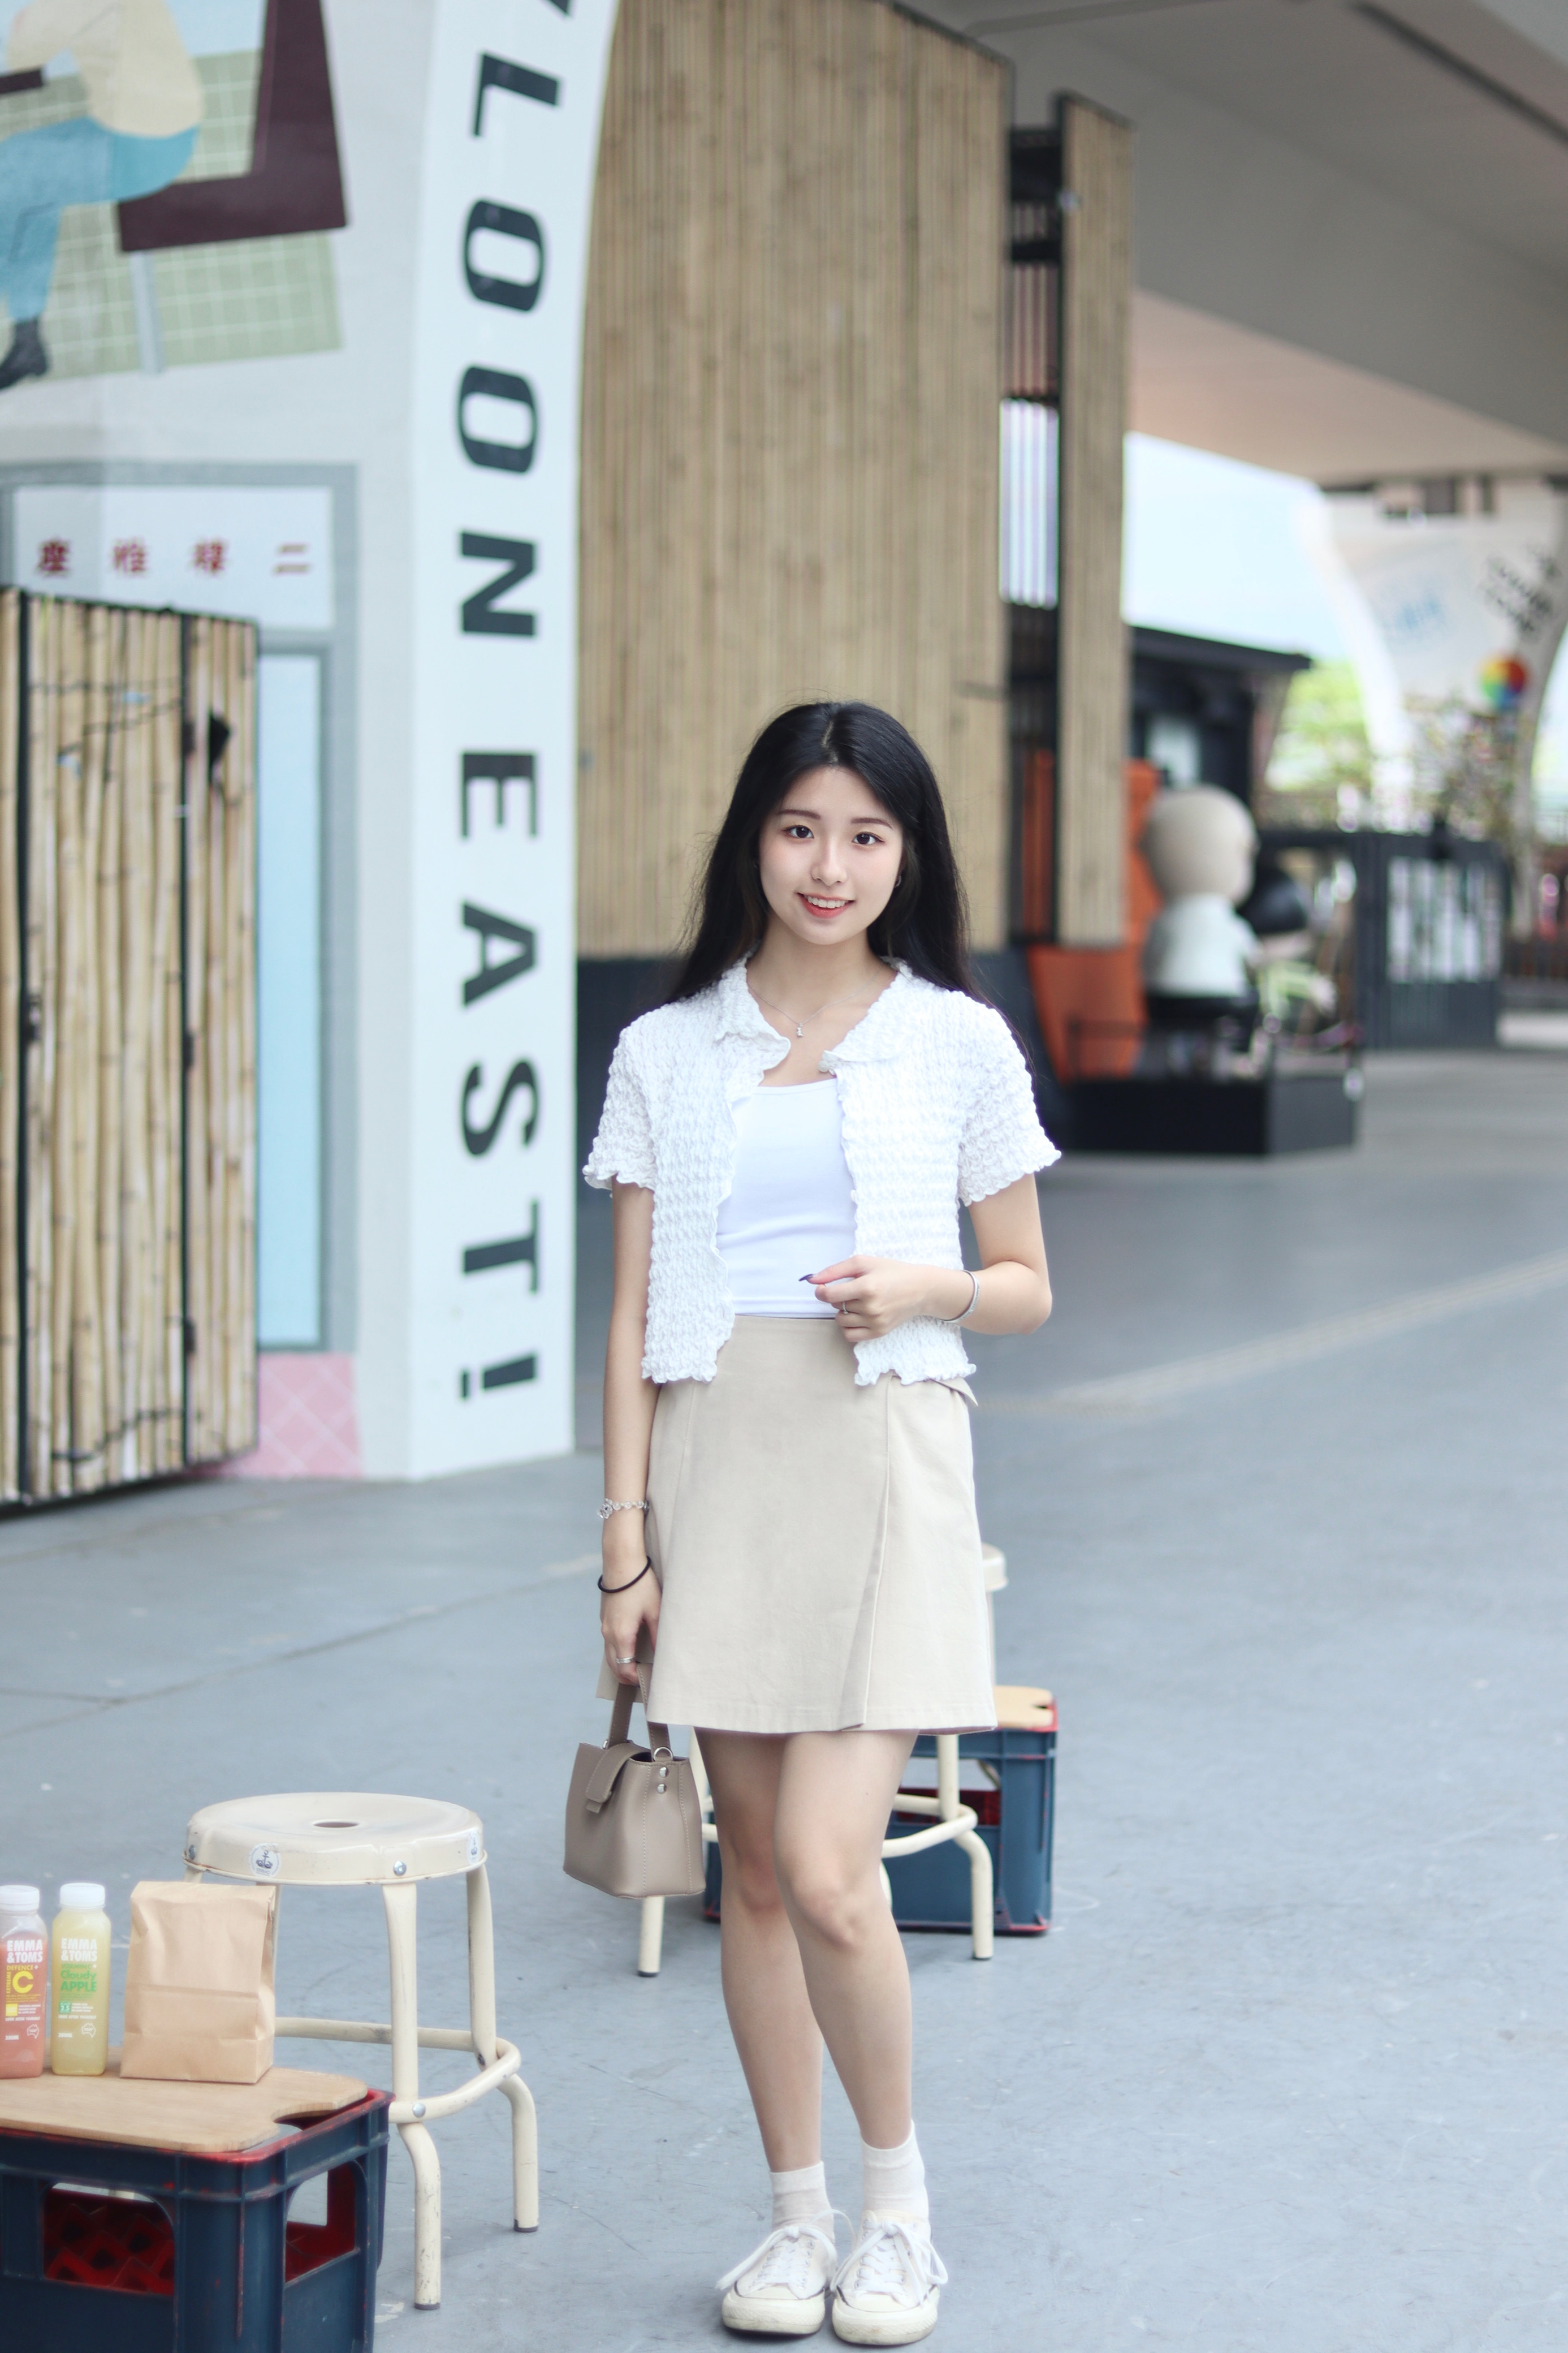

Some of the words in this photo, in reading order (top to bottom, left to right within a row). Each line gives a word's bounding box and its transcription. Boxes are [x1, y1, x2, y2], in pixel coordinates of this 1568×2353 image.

[457, 0, 571, 638] LOON
[460, 750, 539, 1400] EAST!
[7, 1940, 43, 1951] EMMA
[61, 1938, 97, 1950] EMMA
[61, 1970, 97, 1982] Cloudy
[12, 1971, 33, 1994] C
[60, 1980, 97, 1992] APPLE
